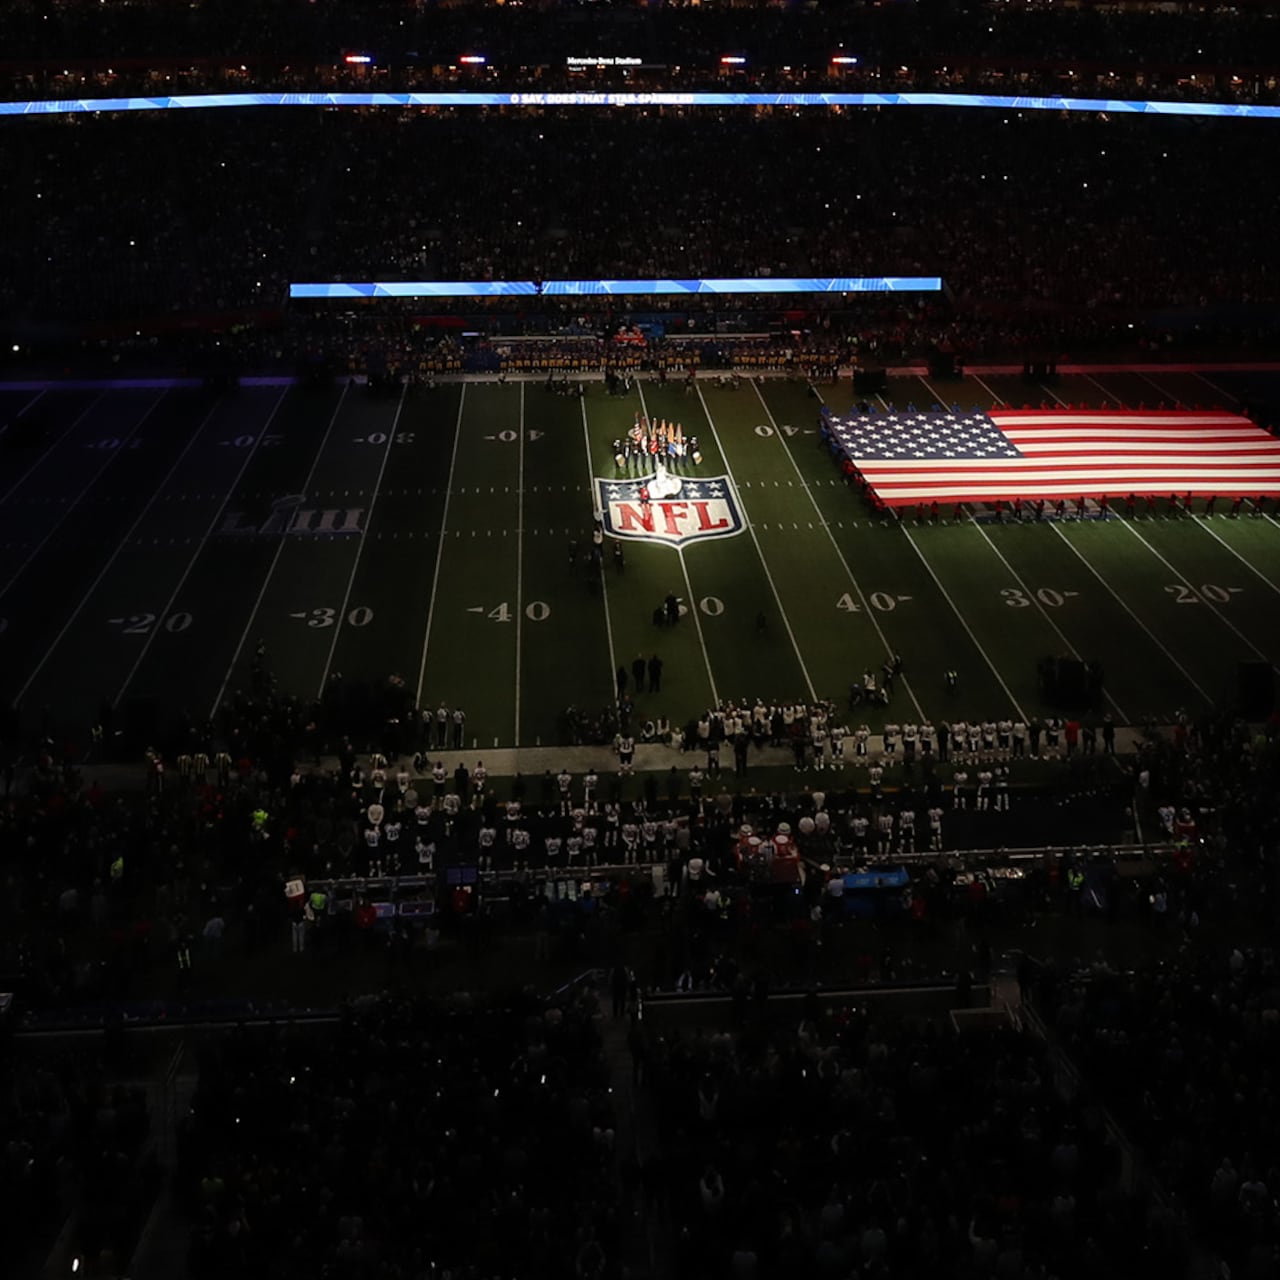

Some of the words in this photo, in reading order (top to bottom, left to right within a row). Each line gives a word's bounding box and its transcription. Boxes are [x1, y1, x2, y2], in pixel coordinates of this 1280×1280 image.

[566, 56, 614, 66] Mercedes-Benz
[614, 56, 642, 66] Stadium
[510, 93, 519, 104] O
[521, 93, 545, 105] SAY,
[577, 93, 606, 104] THAT
[615, 501, 729, 536] NFL
[835, 591, 898, 613] 40
[999, 586, 1067, 609] 30
[1162, 583, 1233, 605] 20
[306, 605, 376, 629] 30
[486, 600, 552, 623] 40
[121, 612, 194, 635] 20
